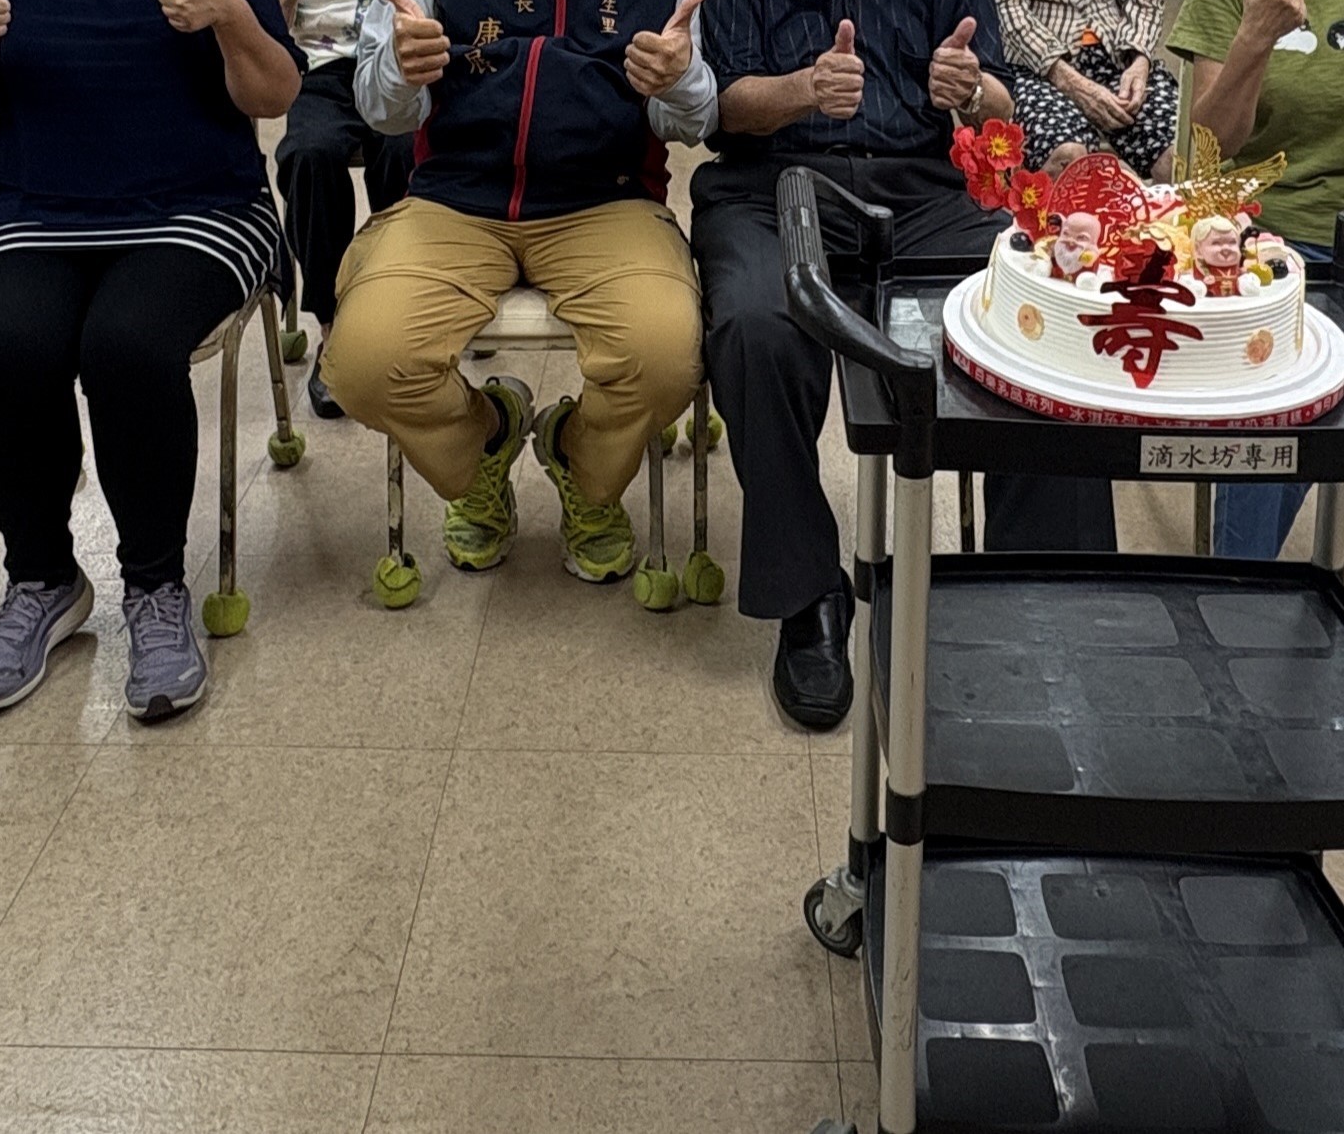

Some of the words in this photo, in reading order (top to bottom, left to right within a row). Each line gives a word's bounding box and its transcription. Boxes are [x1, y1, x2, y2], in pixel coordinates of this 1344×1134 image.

[1147, 443, 1294, 470] 滴水坊專用
